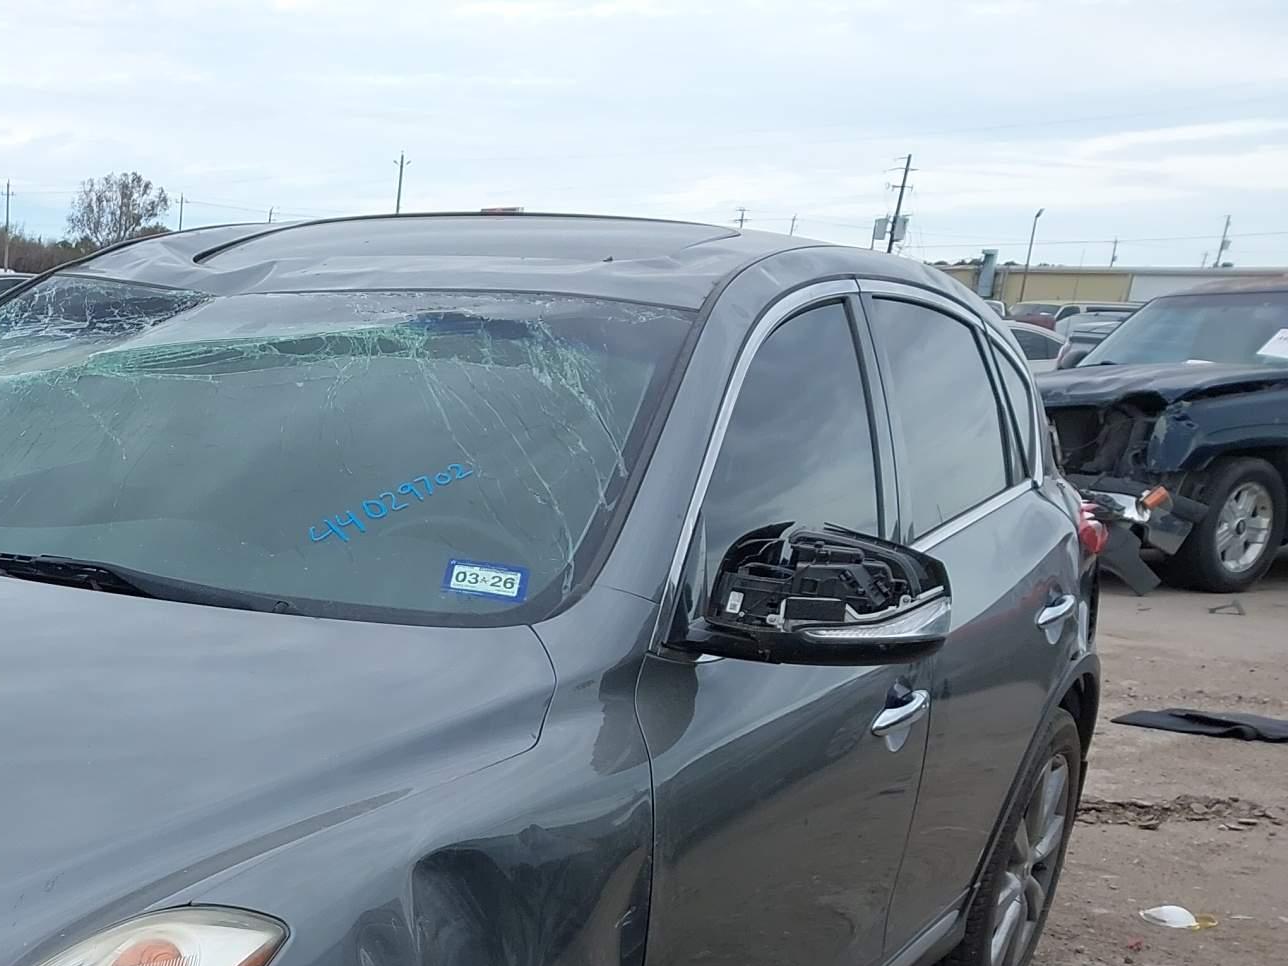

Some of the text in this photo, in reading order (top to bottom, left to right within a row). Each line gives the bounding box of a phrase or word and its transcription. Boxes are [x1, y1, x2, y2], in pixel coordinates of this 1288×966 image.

[309, 463, 474, 542] 44029702
[455, 570, 480, 585] 03
[489, 575, 516, 590] 26
